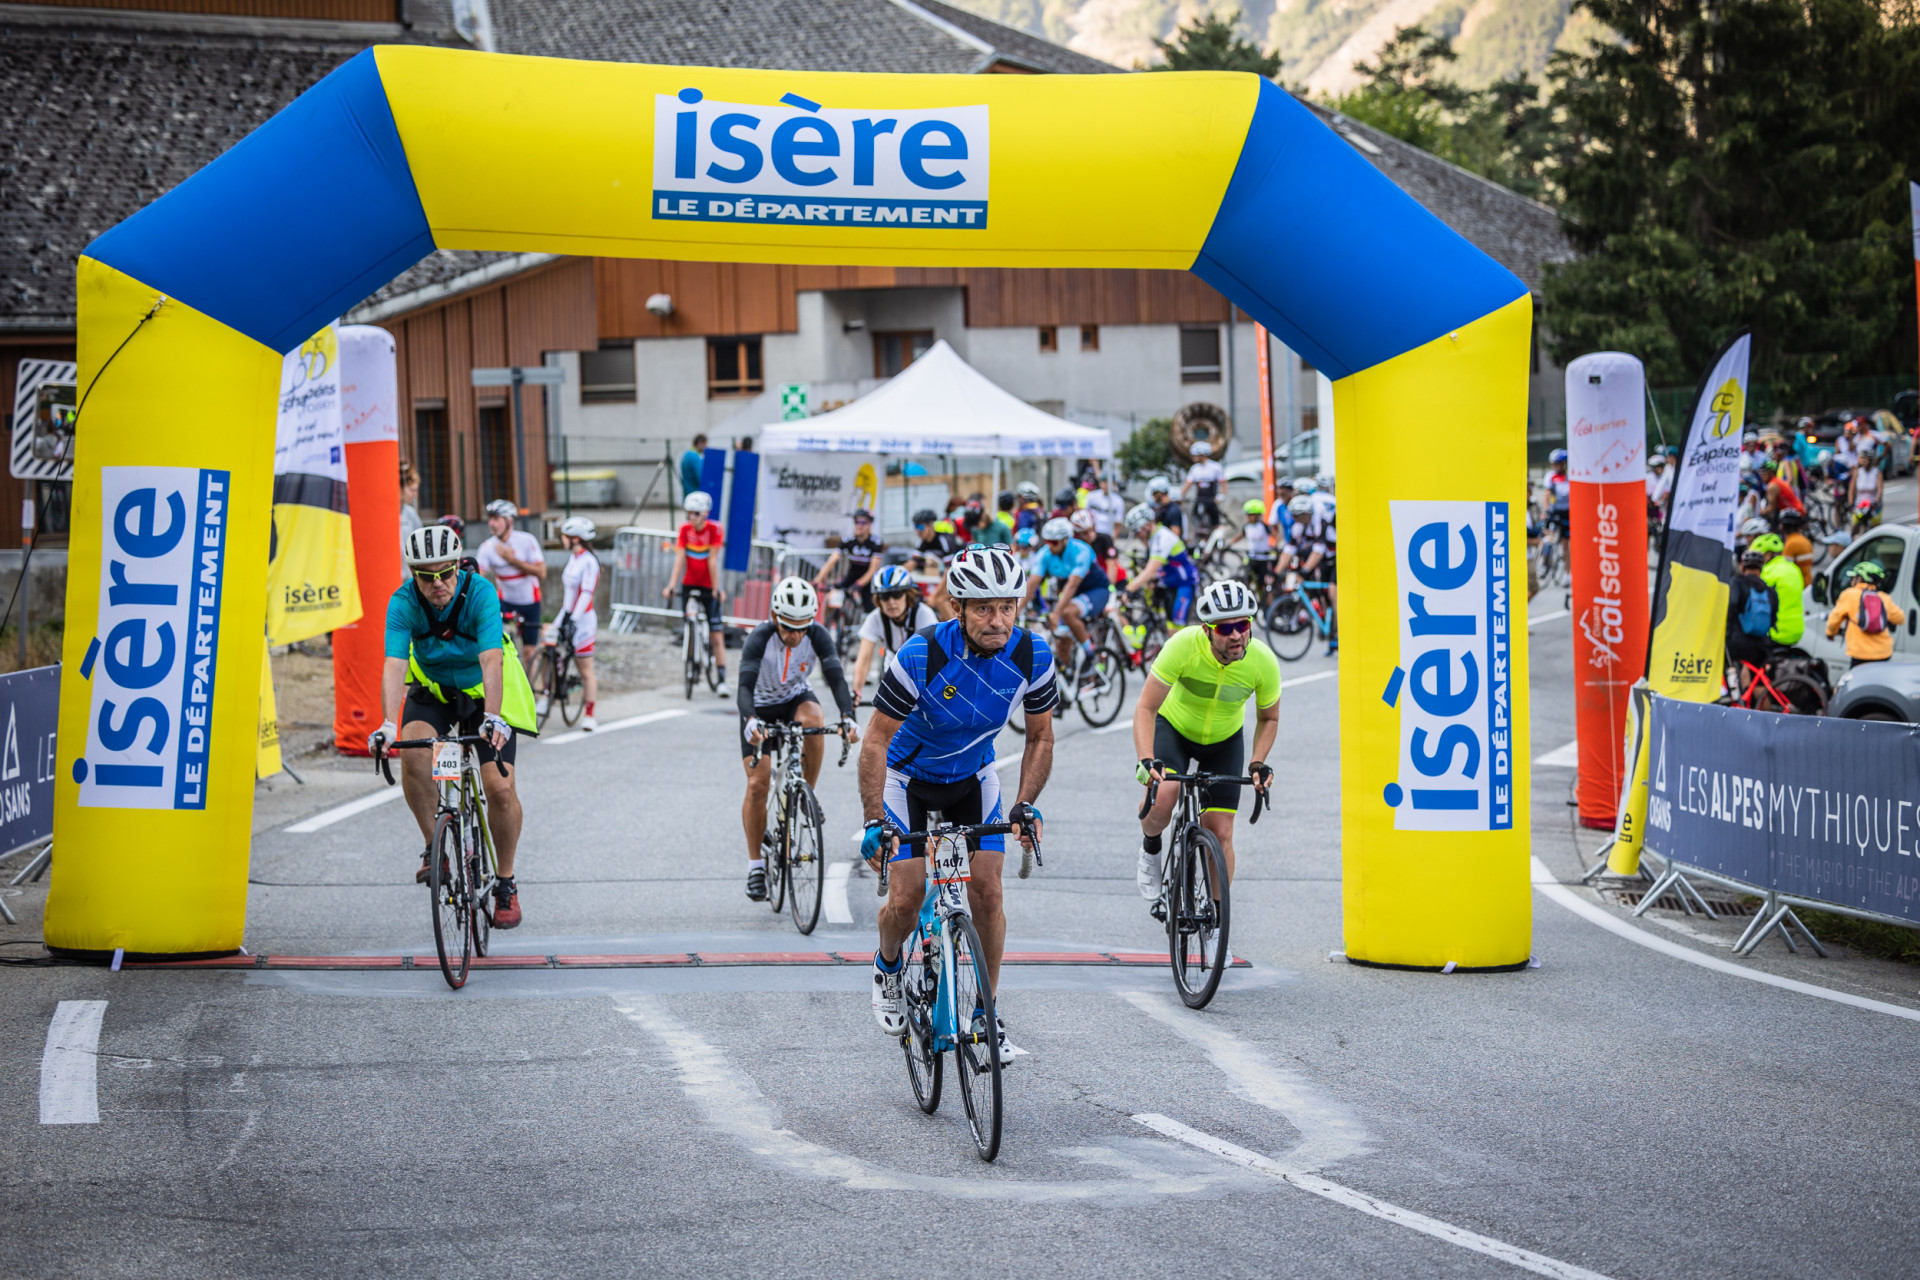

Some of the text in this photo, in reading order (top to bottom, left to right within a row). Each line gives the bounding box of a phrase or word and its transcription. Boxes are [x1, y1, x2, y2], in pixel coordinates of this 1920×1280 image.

[675, 88, 969, 190] isère
[658, 197, 983, 224] LE DÉPARTEMENT
[285, 584, 340, 605] isère
[72, 487, 186, 788] isère
[183, 473, 224, 804] LE DÉPARTEMENT
[1491, 506, 1509, 824] LE DÉPARTEMENT
[1673, 652, 1713, 674] isère
[1381, 521, 1481, 811] isère
[436, 760, 458, 768] 1403
[1678, 763, 1708, 817] LES
[1710, 770, 1765, 831] ALPES
[935, 856, 964, 869] 1407
[1805, 857, 1844, 887] MAGIC
[1846, 864, 1863, 890] OF
[1867, 868, 1893, 897] THE
[1896, 874, 1920, 902] ALP
